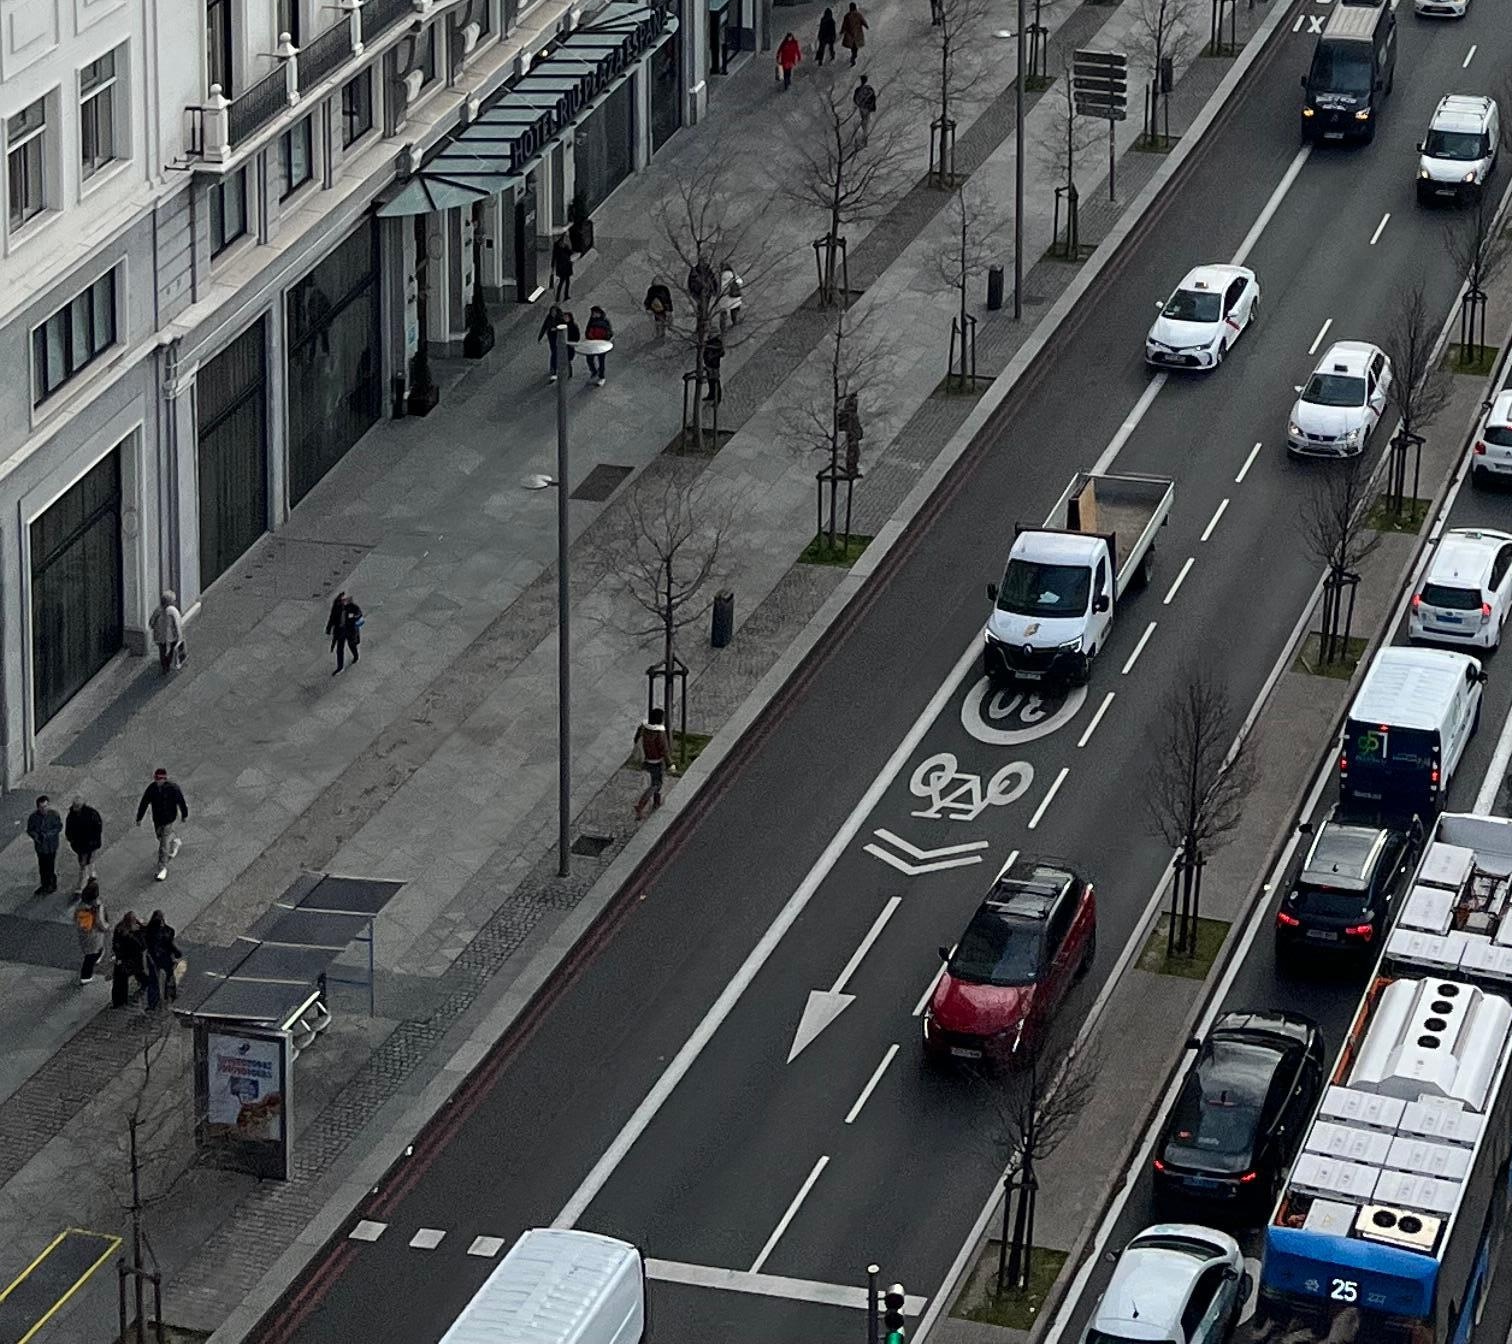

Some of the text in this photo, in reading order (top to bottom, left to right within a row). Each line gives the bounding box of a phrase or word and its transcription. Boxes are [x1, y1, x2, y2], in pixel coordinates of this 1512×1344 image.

[513, 109, 559, 169] HOTEL
[560, 74, 581, 126] RIU
[584, 44, 624, 103] PLAZA
[1330, 1278, 1357, 1302] 25
